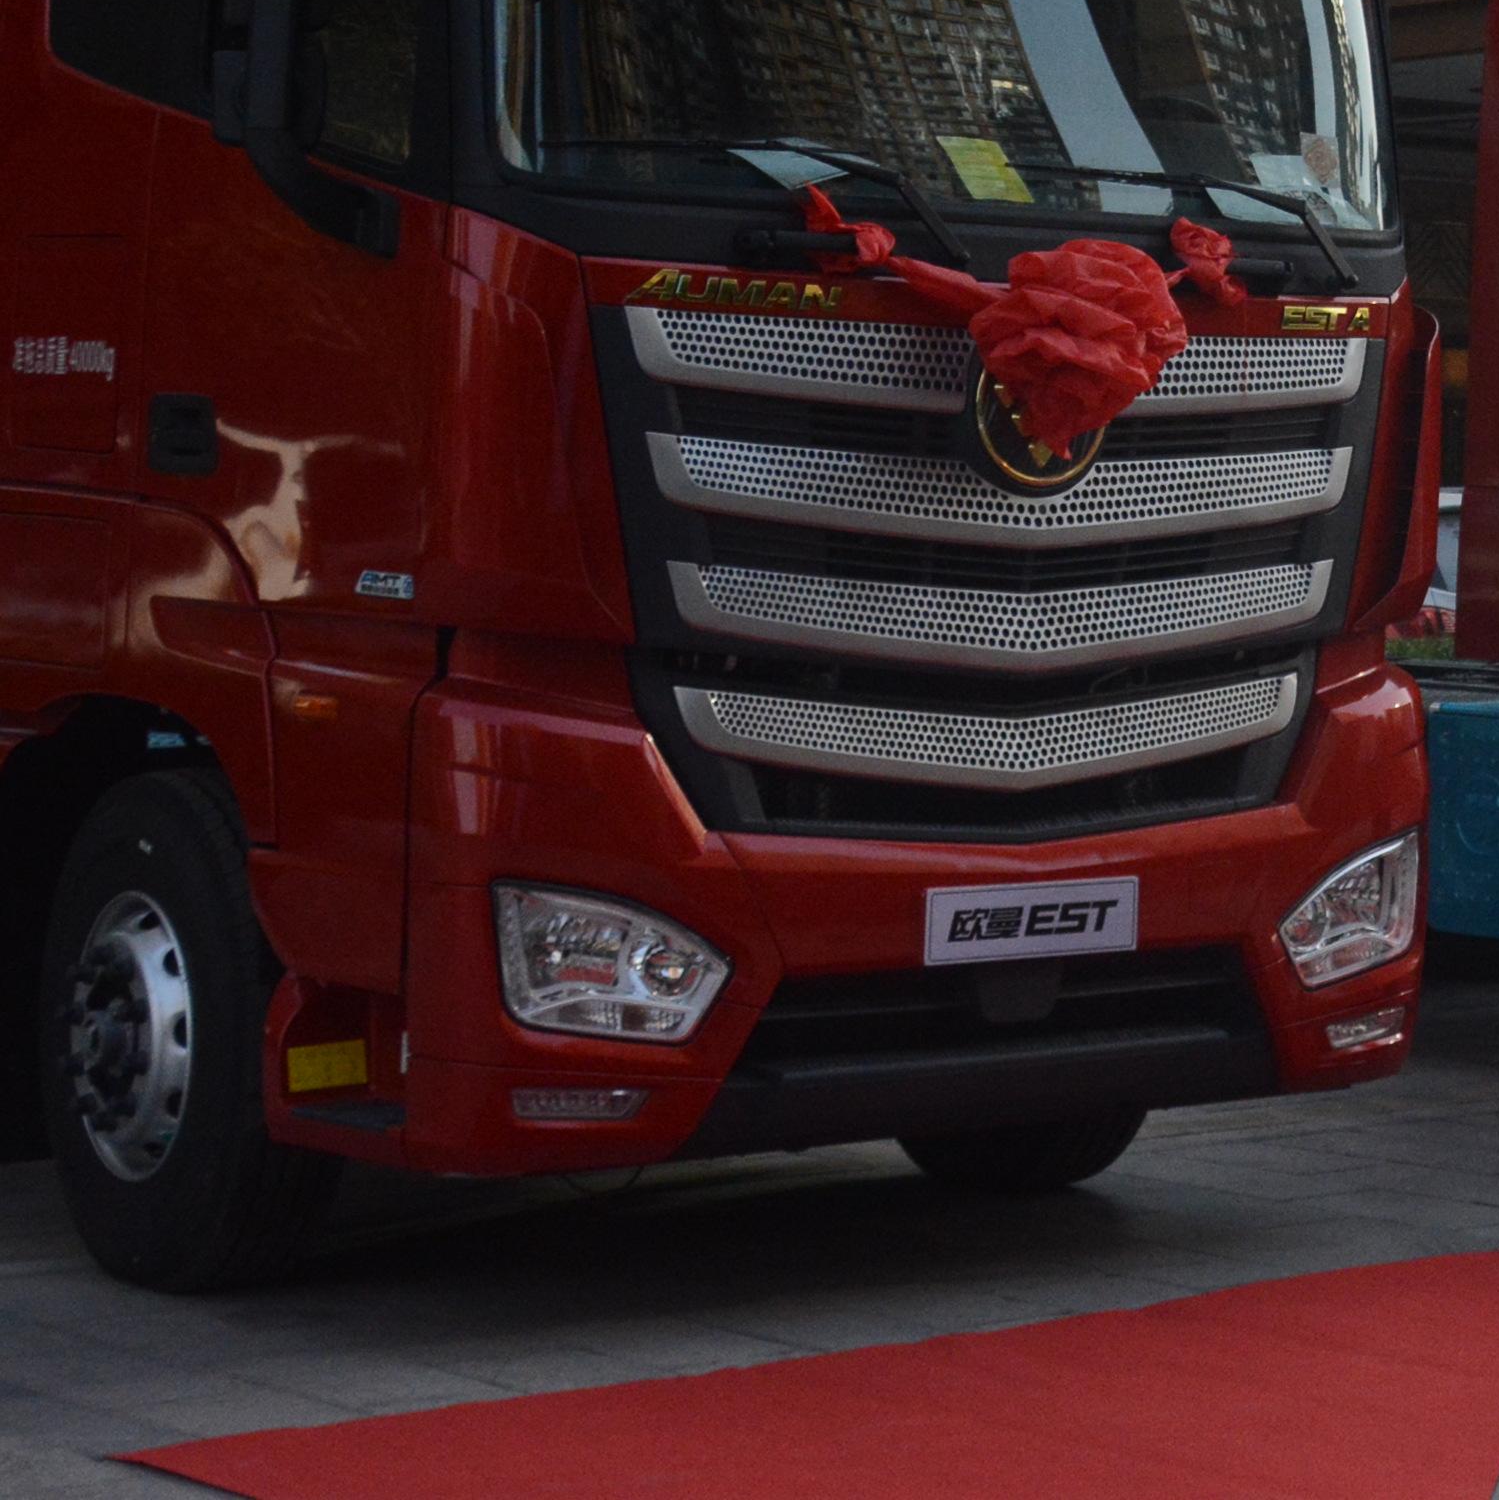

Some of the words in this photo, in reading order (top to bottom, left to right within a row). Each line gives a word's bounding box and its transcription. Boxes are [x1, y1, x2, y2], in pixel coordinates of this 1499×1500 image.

[624, 267, 843, 311] AUMAN
[1281, 305, 1348, 331] EST
[1347, 306, 1370, 331] A
